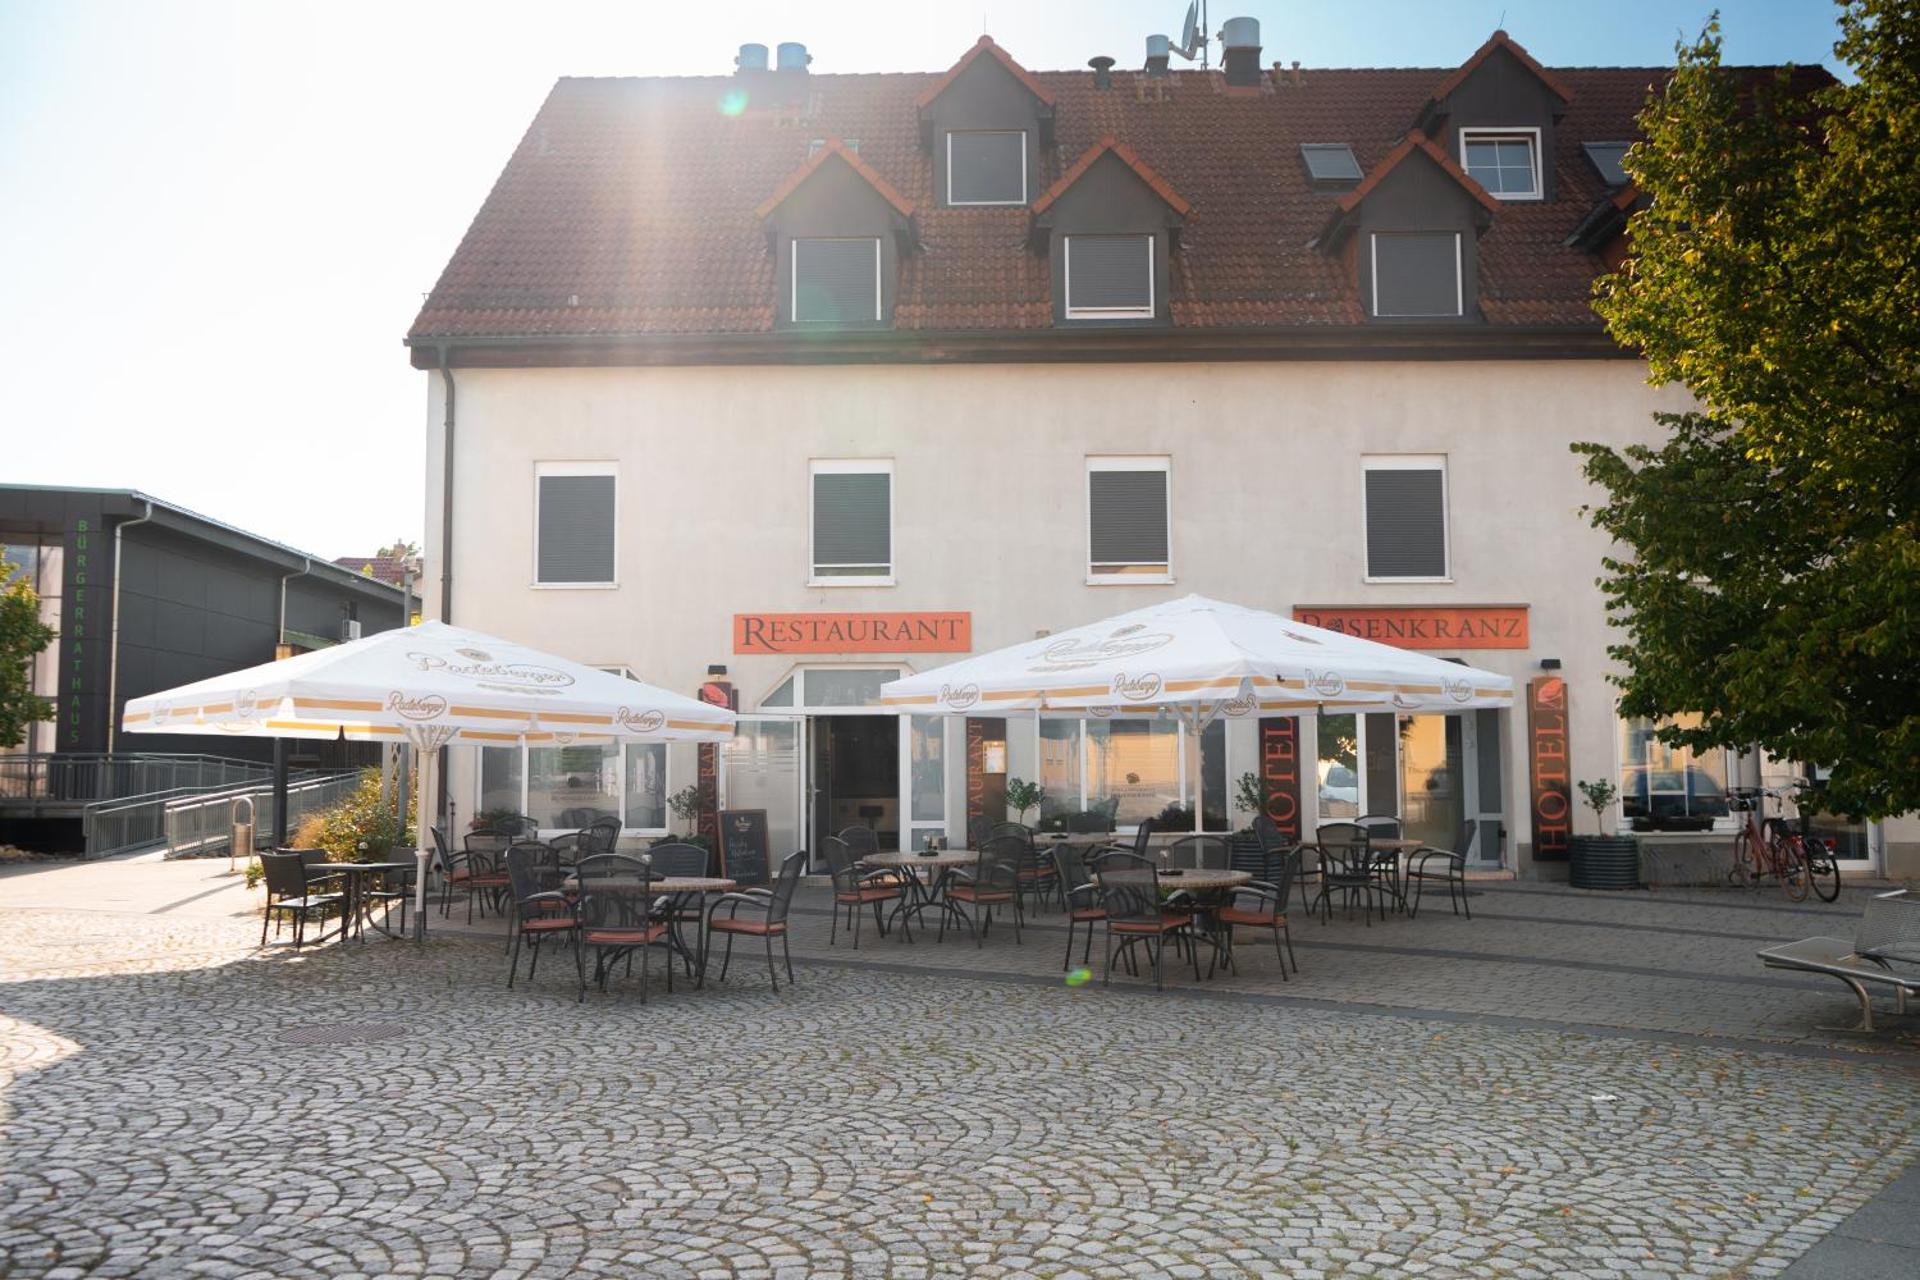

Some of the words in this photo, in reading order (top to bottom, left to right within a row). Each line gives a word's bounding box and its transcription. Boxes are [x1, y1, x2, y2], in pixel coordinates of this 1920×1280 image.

[71, 519, 88, 744] BÜRGERRATHAUS
[742, 617, 964, 651] RESTAURANT
[387, 691, 447, 721] Radeberger
[1536, 714, 1567, 854] HOTEL
